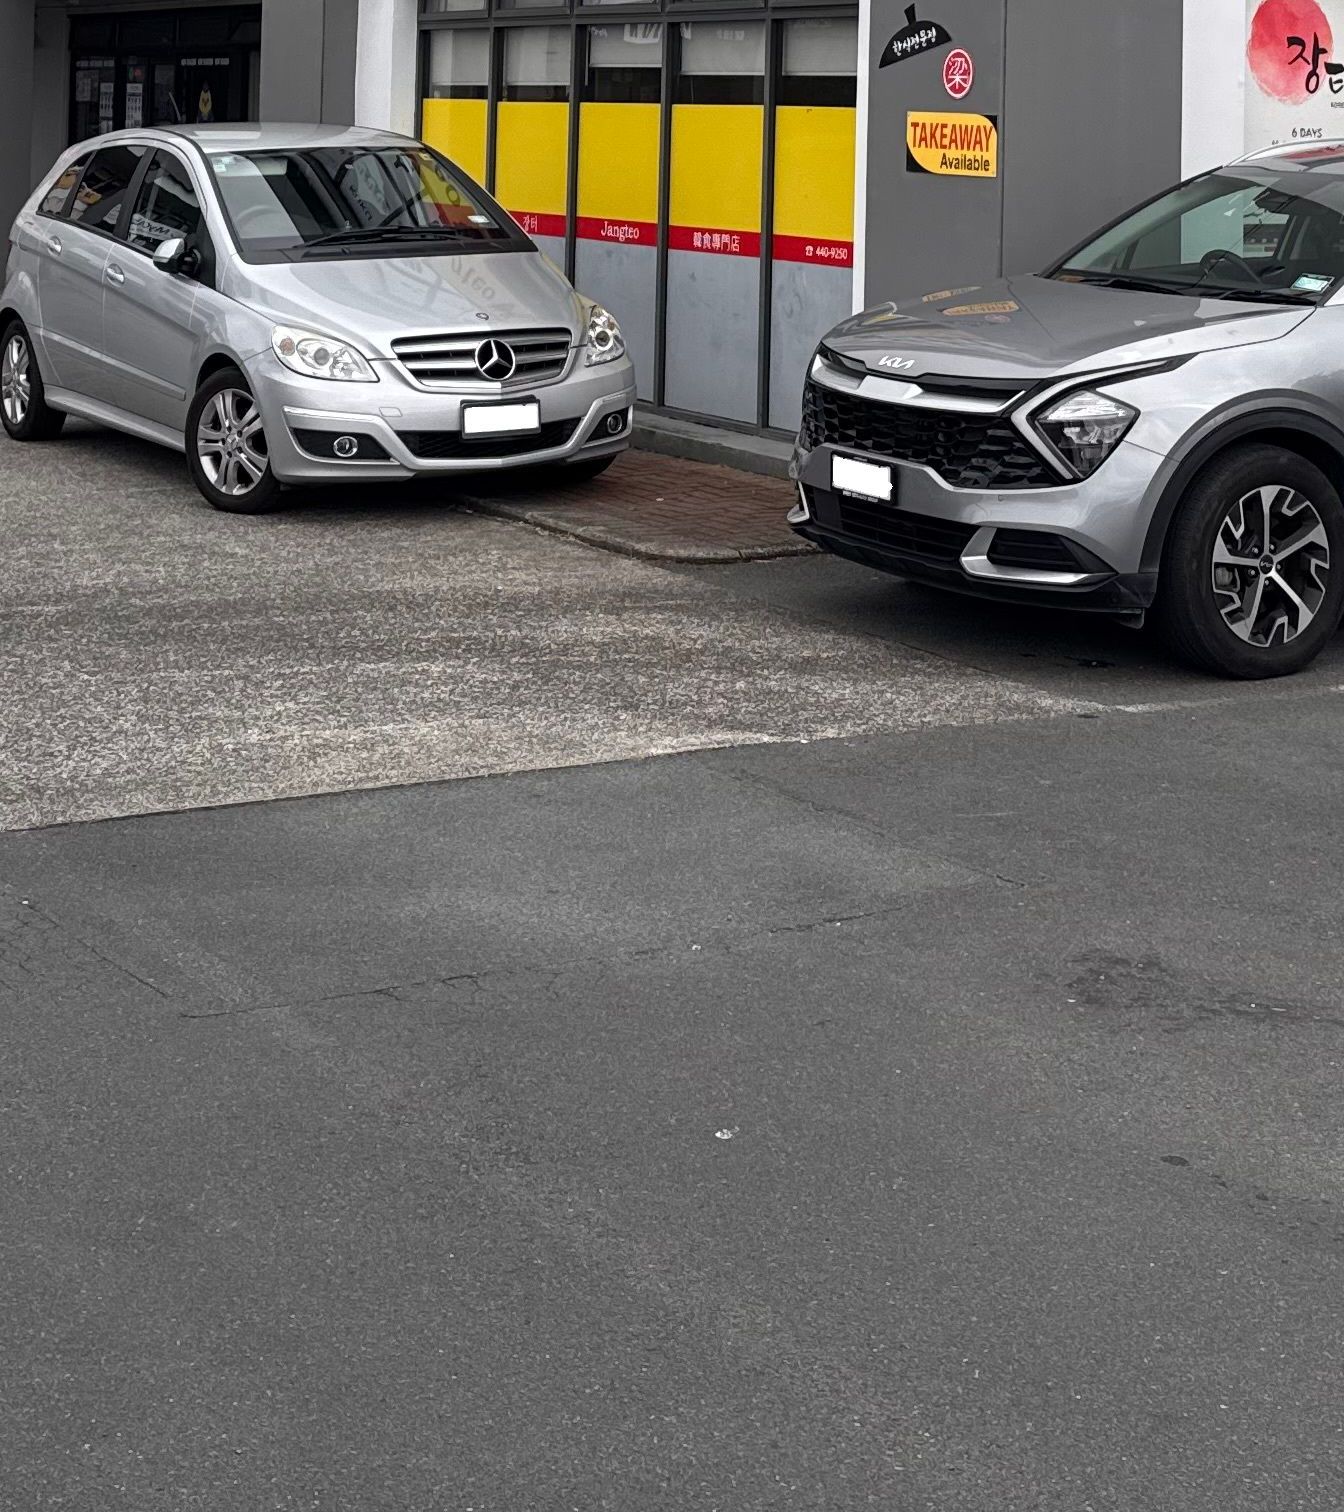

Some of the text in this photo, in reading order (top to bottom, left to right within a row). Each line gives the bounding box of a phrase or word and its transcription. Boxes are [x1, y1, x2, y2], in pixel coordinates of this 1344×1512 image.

[910, 121, 994, 153] TAKEAWAY
[1291, 127, 1323, 139] 6 DAYS
[939, 152, 991, 172] Available
[522, 215, 538, 233] 장터
[600, 220, 640, 242] Jangteo
[815, 245, 848, 260] 440-9250
